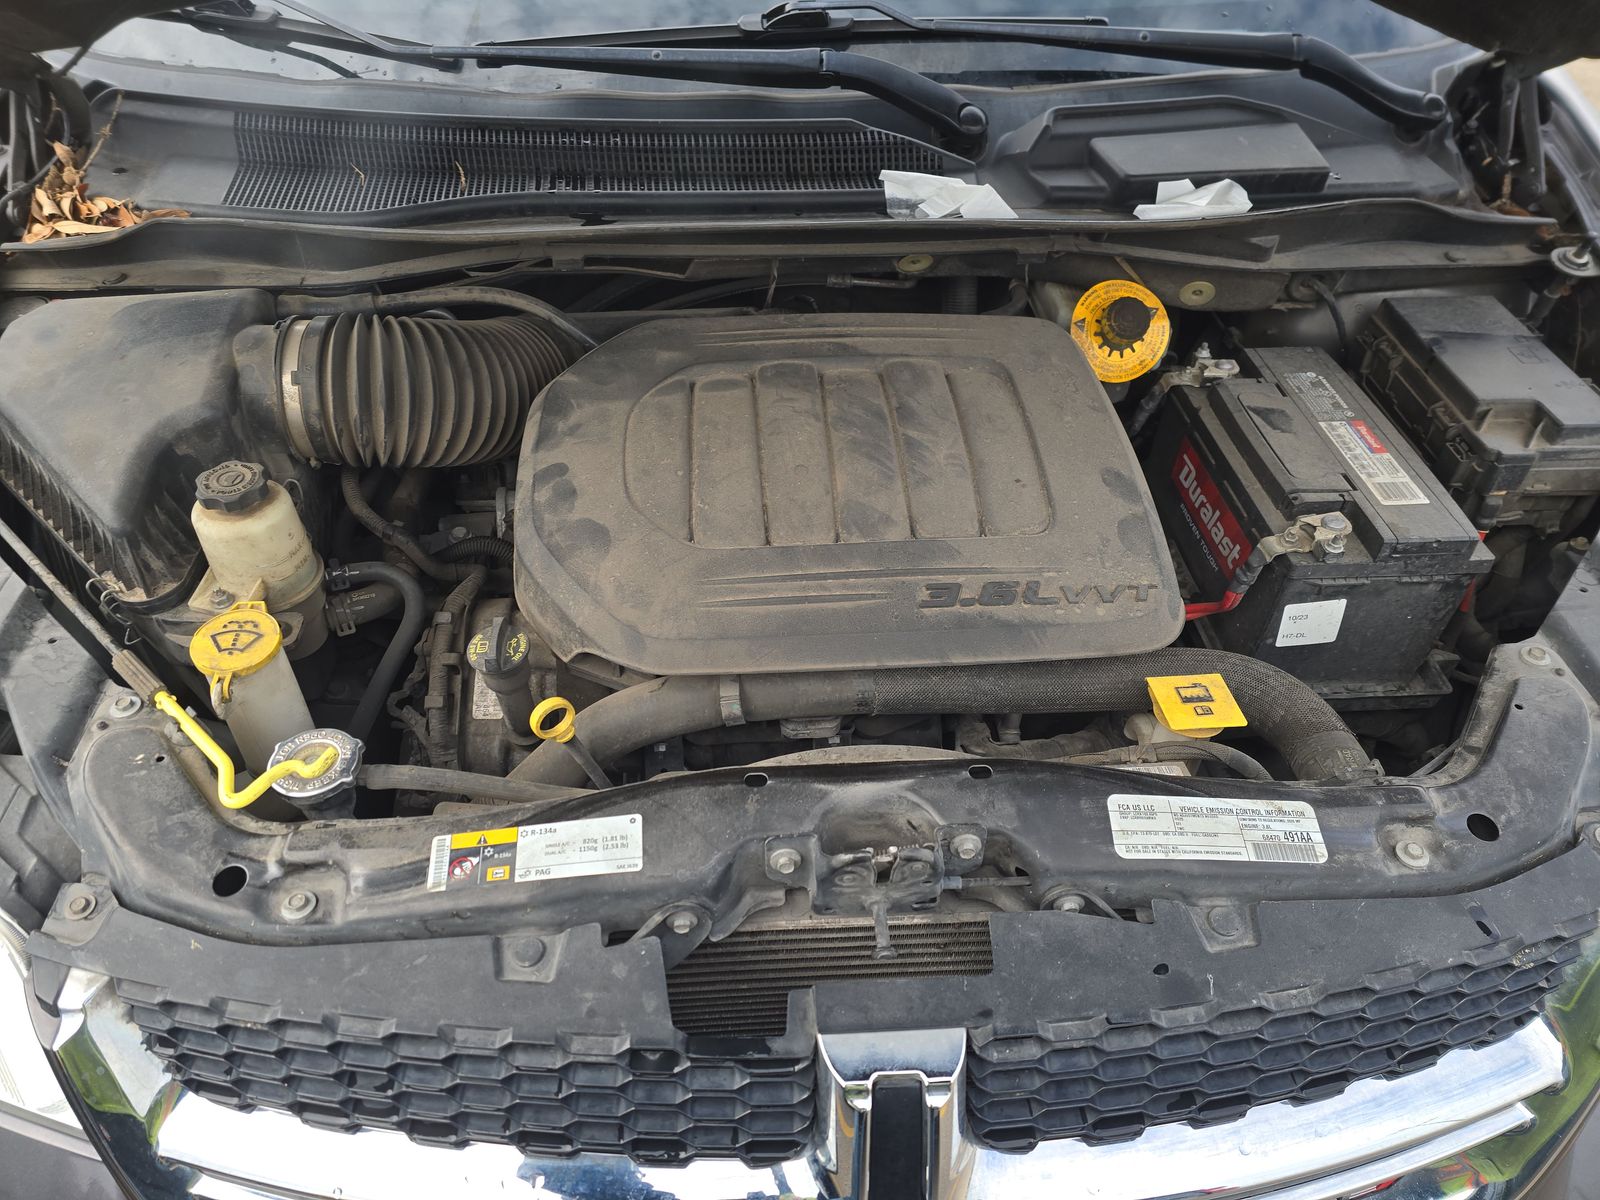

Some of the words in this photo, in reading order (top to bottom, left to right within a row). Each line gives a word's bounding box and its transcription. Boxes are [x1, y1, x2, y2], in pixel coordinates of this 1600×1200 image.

[1179, 453, 1240, 570] Duralast
[1180, 503, 1201, 540] PROVEN
[1200, 539, 1219, 573] TOUGH
[919, 581, 1060, 608] 3.6L
[1060, 584, 1158, 604] VVT
[517, 633, 527, 652] ENGINE
[511, 652, 523, 661] OIL
[295, 731, 327, 745] OPEN
[275, 742, 296, 760] HOT
[1179, 806, 1205, 814] VEHICLE
[1206, 807, 1235, 815] EMISSION
[1236, 808, 1264, 816] CONTROL
[1264, 809, 1306, 817] INFORMATION
[531, 828, 557, 836] R-134a
[1283, 831, 1314, 843] 491AA
[535, 868, 551, 876] PAG
